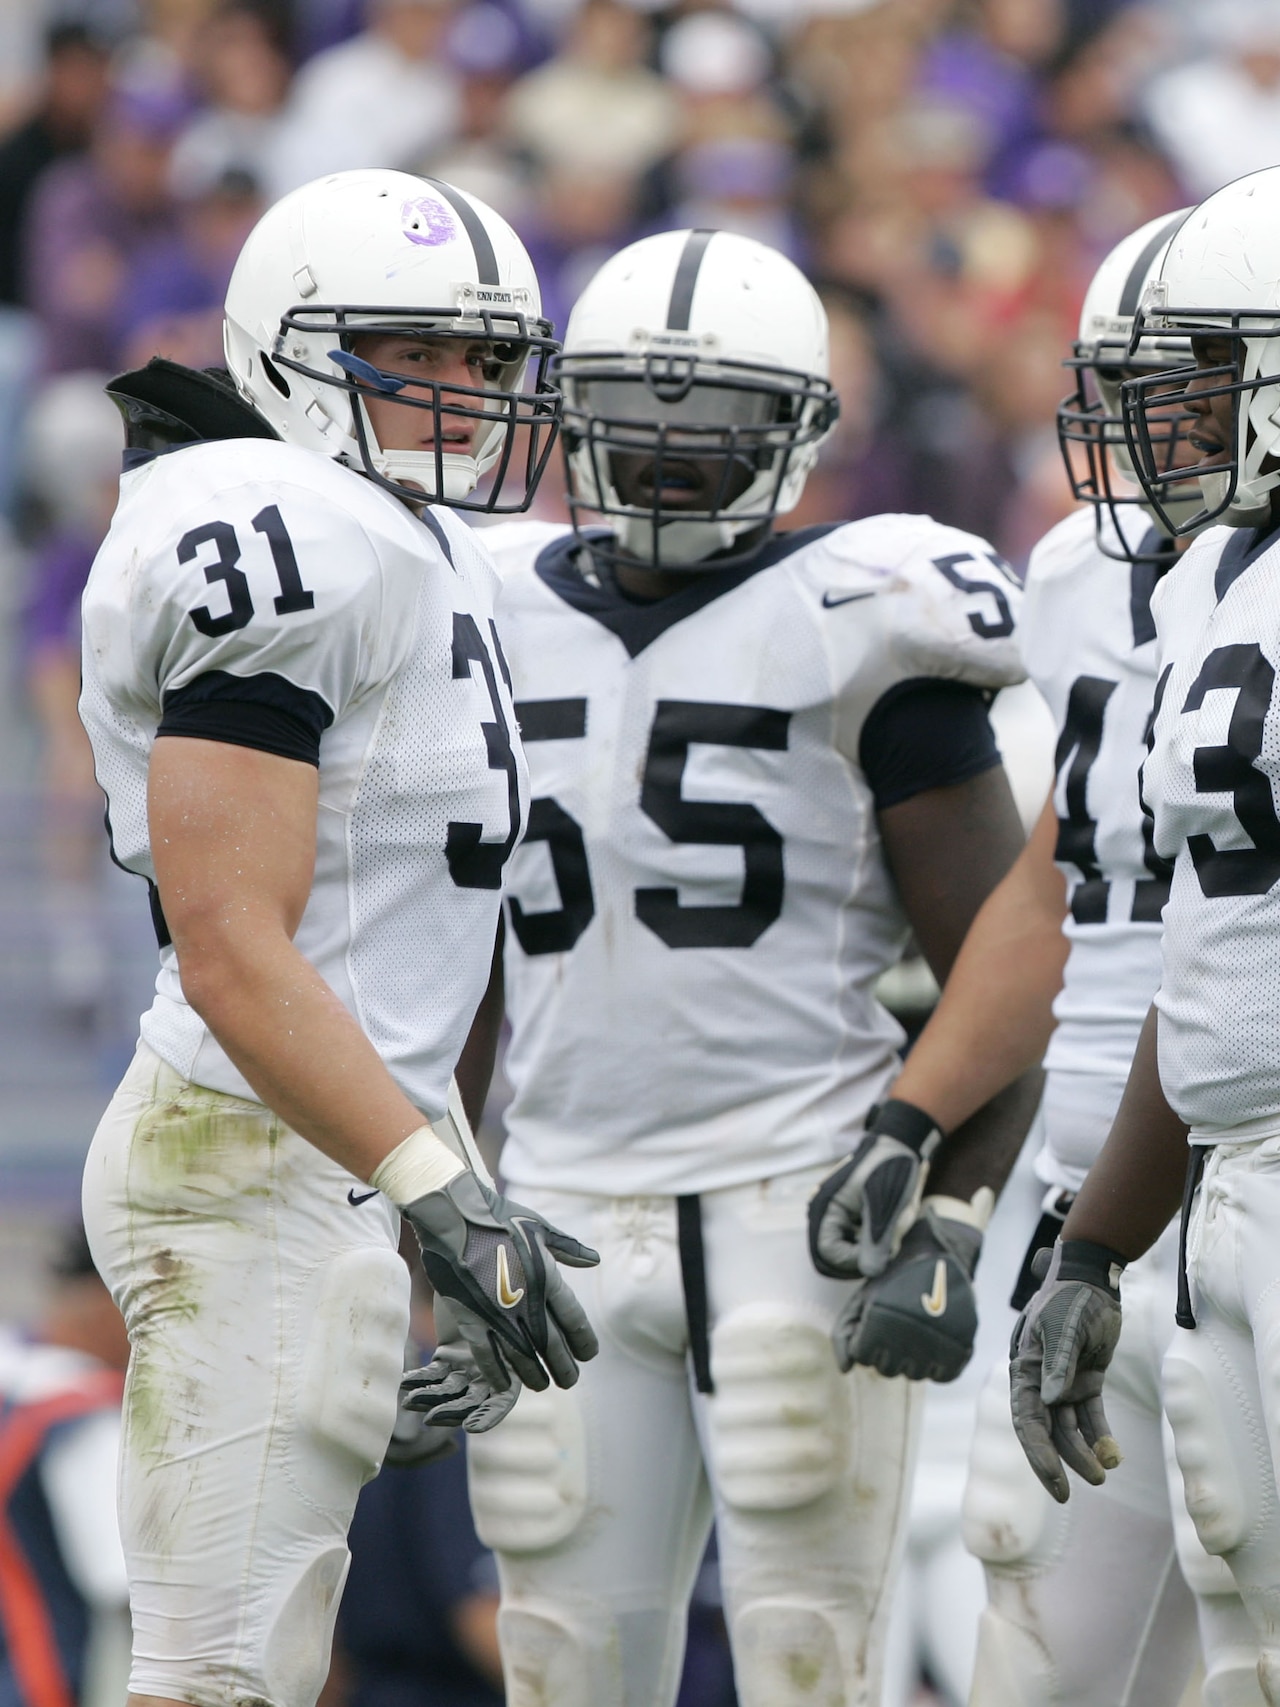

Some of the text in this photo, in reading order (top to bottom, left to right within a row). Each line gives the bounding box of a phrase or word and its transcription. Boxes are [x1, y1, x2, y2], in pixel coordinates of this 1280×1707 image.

[477, 291, 511, 302] ENN STATE
[176, 503, 315, 639] 31
[509, 697, 793, 956] 55
[1054, 675, 1176, 926] 4
